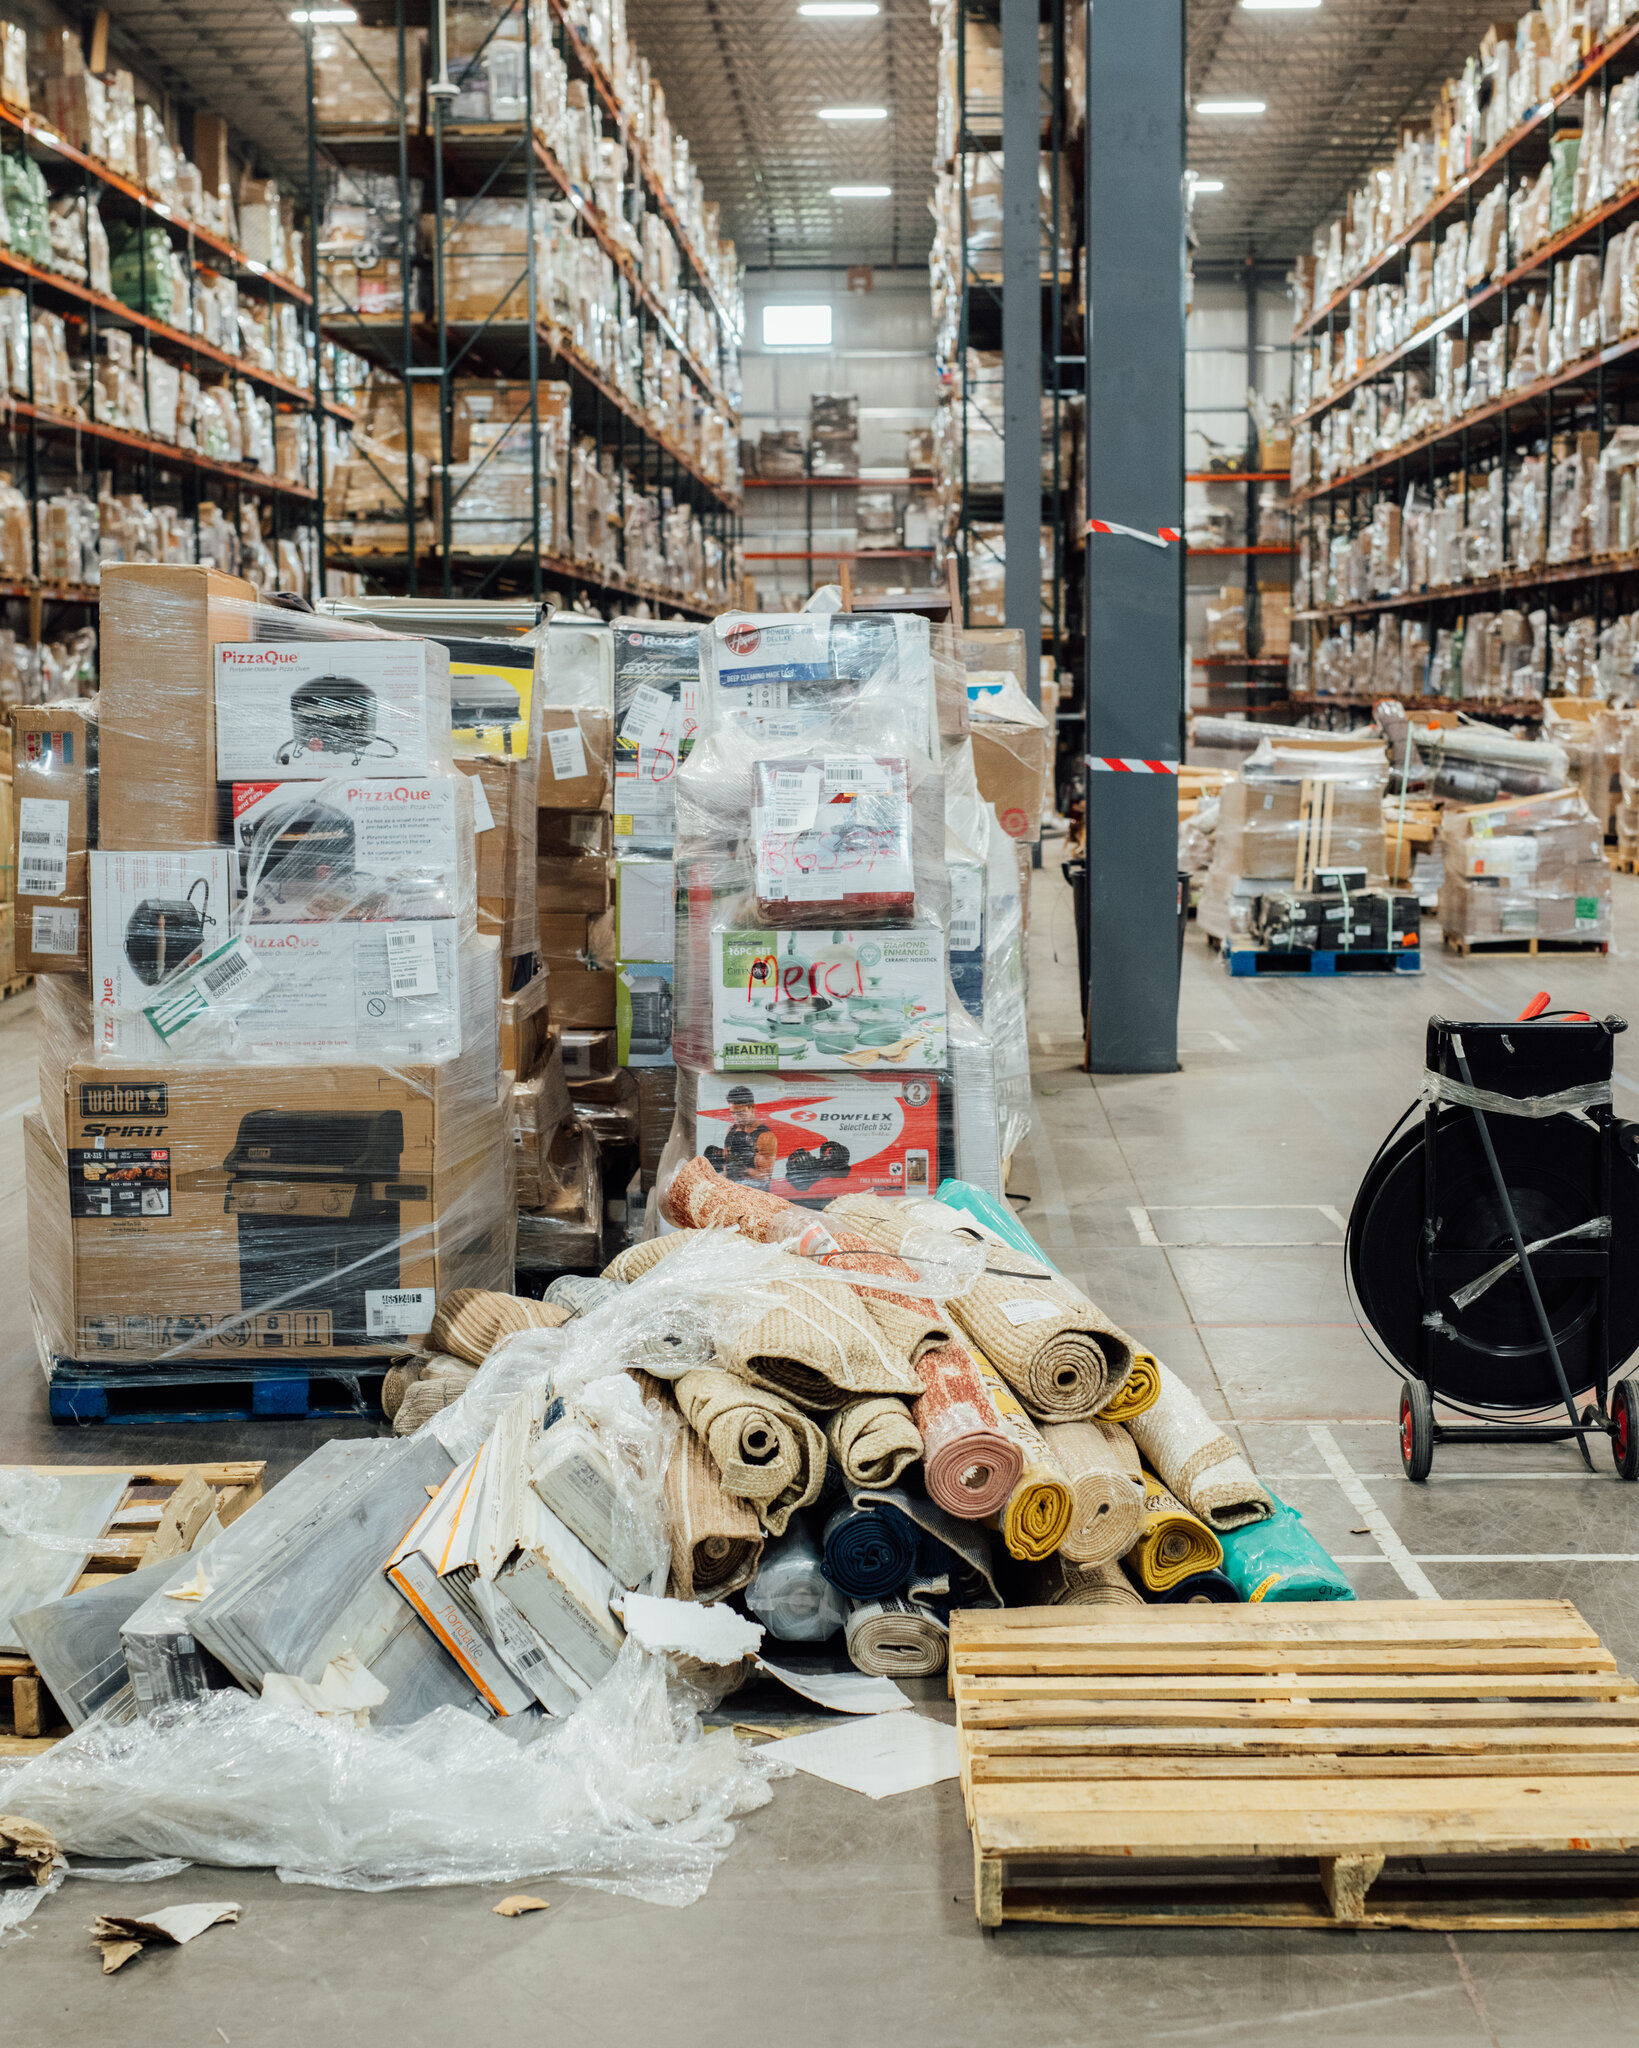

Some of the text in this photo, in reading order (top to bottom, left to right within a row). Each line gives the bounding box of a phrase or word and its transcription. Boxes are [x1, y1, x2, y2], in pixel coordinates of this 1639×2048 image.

[222, 650, 298, 665] PizzaQue
[727, 674, 740, 682] DEEP
[741, 673, 765, 681] CLEANING
[237, 787, 255, 802] Quick
[238, 789, 264, 811] and Easy
[347, 787, 430, 803] PizzaQue
[244, 934, 320, 949] PizzaQue
[755, 947, 771, 955] SET
[883, 949, 930, 957] ENHANCED
[725, 1045, 776, 1055] HEALTHY
[88, 1085, 144, 1112] weber
[820, 1113, 893, 1121] BOWFLEX
[81, 1124, 168, 1137] SPIRIT
[839, 1123, 892, 1131] SelectTech 552
[437, 1604, 484, 1657] floridatile
